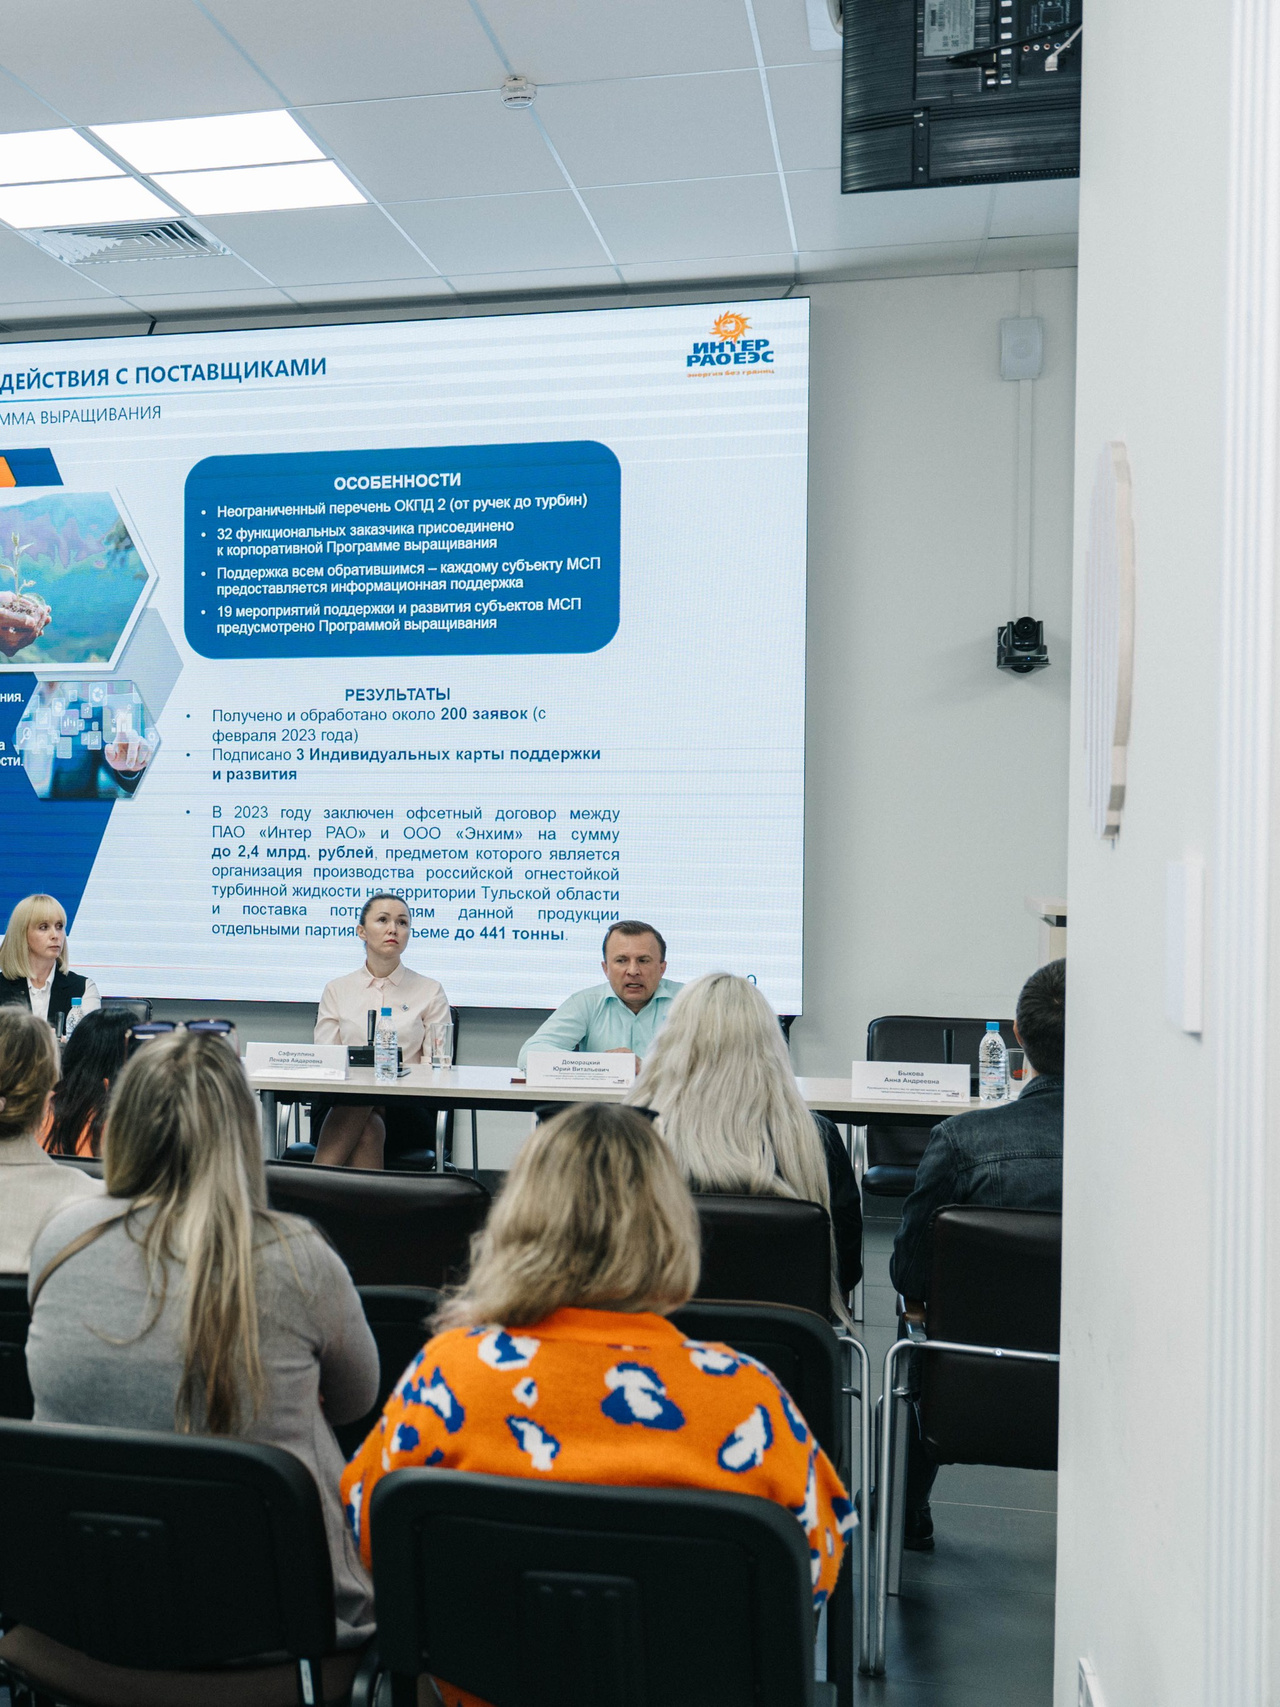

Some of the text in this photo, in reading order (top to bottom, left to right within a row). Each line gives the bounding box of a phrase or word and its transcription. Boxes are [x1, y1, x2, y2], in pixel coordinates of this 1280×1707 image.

[693, 339, 770, 354] ИНТЕР
[116, 368, 128, 384] С
[136, 358, 326, 384] ПОСТАВЩИКАМИ
[41, 406, 160, 424] ВЫРАЩИВАНИЯ
[334, 473, 461, 490] ОСОБЕННОСТИ
[218, 493, 587, 519] Неограниченный перечень ОКПД 2 (от ручек до турбин)
[217, 522, 514, 542] 32 функциональных заказчика присоединено
[217, 539, 497, 558] к корпоративной Программе выращивания
[218, 567, 288, 581] Поддержка
[292, 567, 323, 577] всем
[327, 564, 424, 578] обратившимся
[441, 563, 498, 575] каждому
[502, 559, 563, 575] субъекту
[567, 557, 600, 570] МСП
[217, 579, 523, 598] предоставляется информационная поддержка
[218, 598, 581, 620] 19 мероприятий поддержки и развития субъектов МСП
[217, 619, 497, 636] предусмотрено Программой выращивания
[346, 688, 450, 701] РЕЗУЛЬТАТЫ
[213, 706, 546, 725] Получено и обработано около 200 заявок (с
[212, 729, 358, 744] февраля 2023 года)
[213, 748, 600, 763] Подписано 3 Индивидуальных карты поддержки
[213, 771, 296, 783] и развития
[213, 806, 620, 823] В 2023 году заключен офсетный договор между
[213, 826, 619, 843] ПАО «Интер РАО» и ООО «Энхим» на сумму
[212, 845, 619, 863] до 2,4 млрд. рублей, предметом которого является
[212, 867, 619, 881] организация производства российской огнестойкой
[212, 883, 287, 898] турбинной
[292, 887, 360, 899] жидкости
[389, 887, 475, 901] территории
[481, 886, 550, 902] Тульской
[556, 887, 619, 900] области
[212, 905, 220, 914] и
[243, 905, 307, 915] поставка
[458, 907, 513, 920] данной
[538, 910, 619, 923] продукции
[212, 924, 568, 941] отдельными партия ъеме до 441 тонны.
